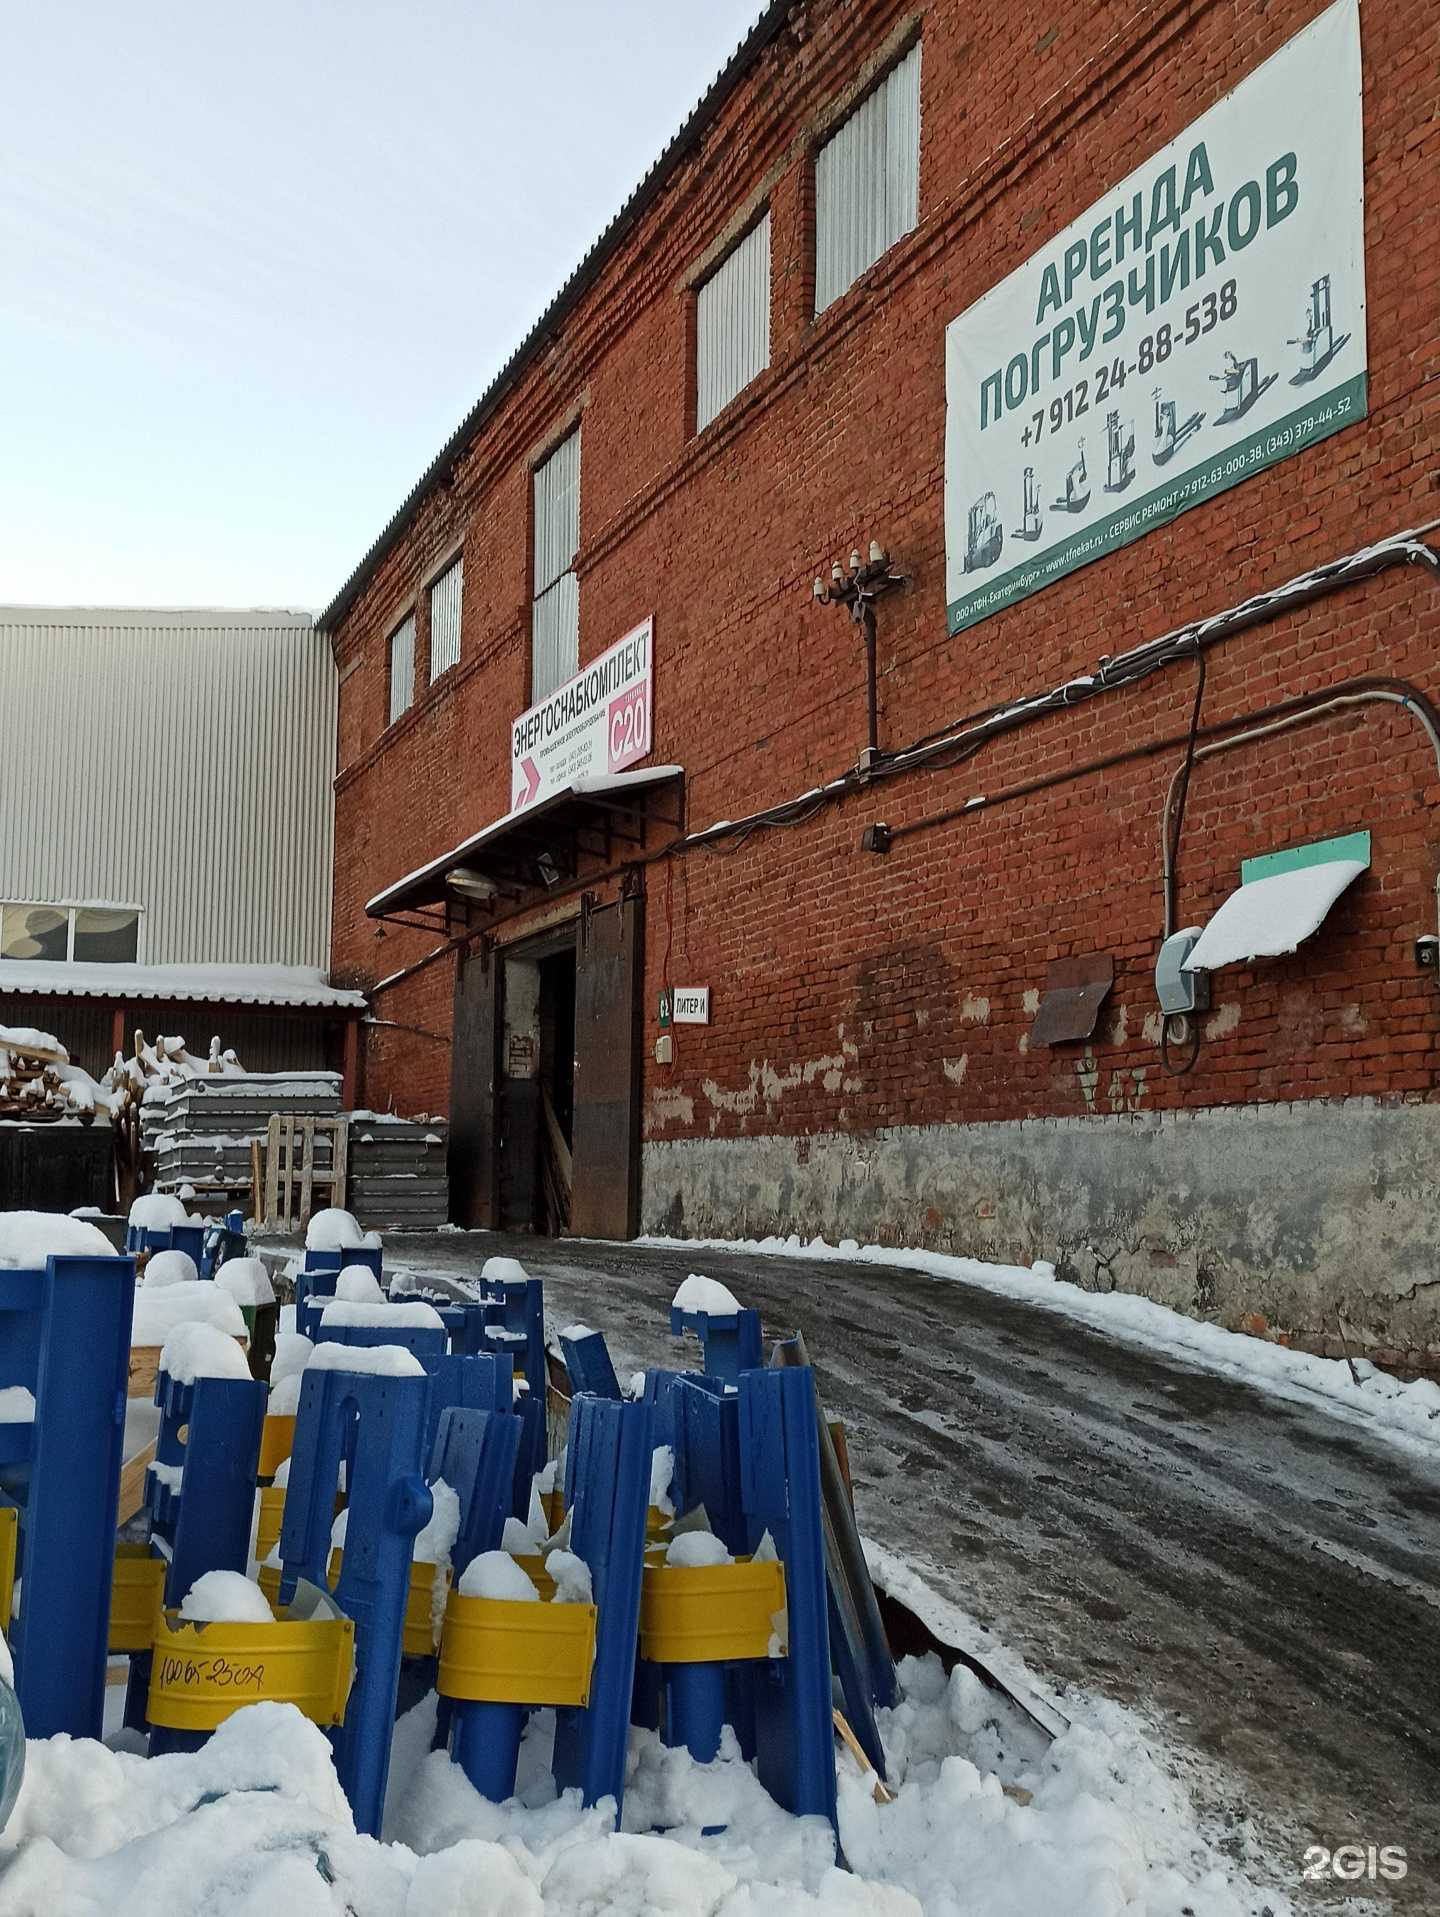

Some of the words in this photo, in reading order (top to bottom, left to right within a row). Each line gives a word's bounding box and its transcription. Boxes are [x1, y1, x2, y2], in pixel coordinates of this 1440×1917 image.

[980, 151, 1299, 431] ПОГРУЗЧИКОВ
[1036, 141, 1214, 325] АРЕНДА
[1021, 409, 1044, 447] +7
[1050, 380, 1089, 434] 912
[1095, 278, 1238, 404] 24-88-538
[956, 606, 969, 622] ООО
[1046, 537, 1103, 574] www.tfnekat.ru
[1109, 512, 1141, 538] СЕРВИС
[1142, 491, 1179, 520] РЕМОНТ
[1180, 485, 1190, 497] +7
[1266, 427, 1294, 456] (343)
[1295, 396, 1351, 439] 379-44-52
[514, 632, 649, 757] ЭНЕРГОСНАБКОМПЛЕКТ
[676, 998, 698, 1013] ЛИТЕР
[700, 998, 705, 1013] И
